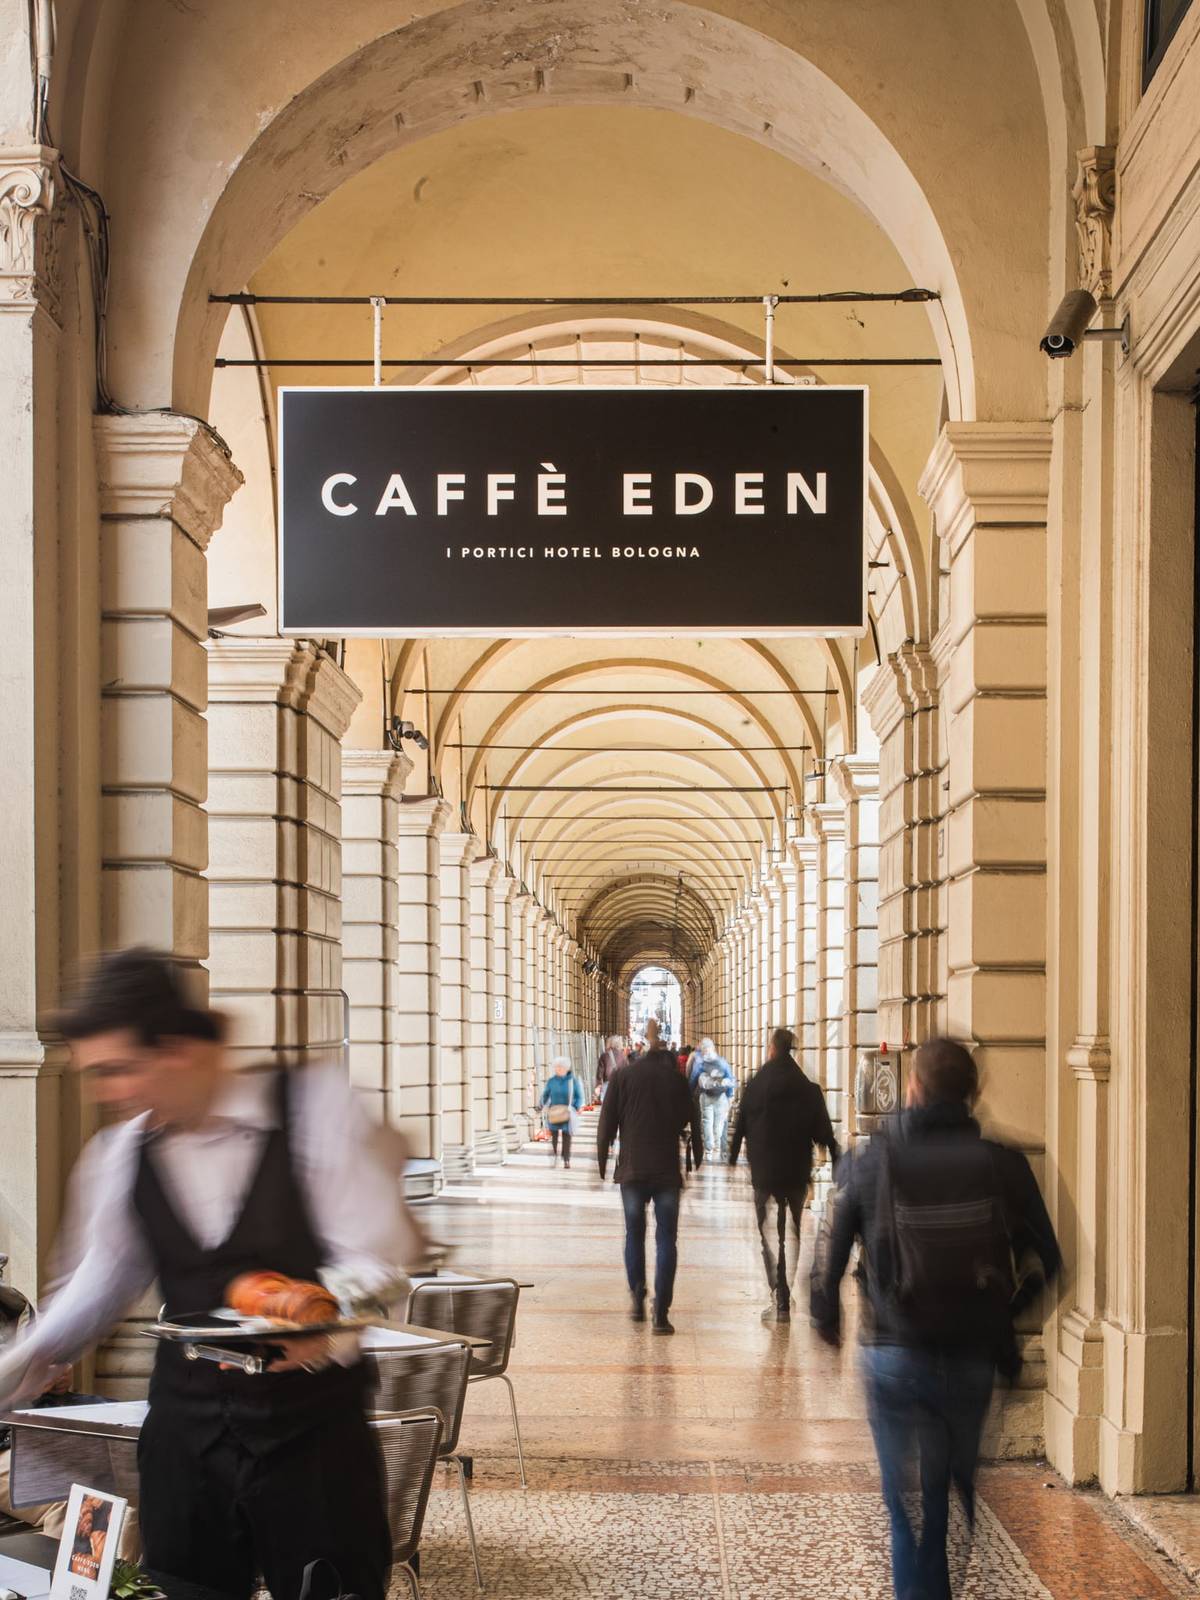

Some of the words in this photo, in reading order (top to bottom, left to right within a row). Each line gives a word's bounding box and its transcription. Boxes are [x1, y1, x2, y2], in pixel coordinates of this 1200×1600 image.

[320, 462, 568, 517] CAFFÈ
[622, 472, 827, 516] EDEN
[446, 546, 451, 559] I
[461, 546, 534, 559] PORTICI
[544, 546, 602, 559] HOTEL
[611, 546, 701, 559] BOLOGNA
